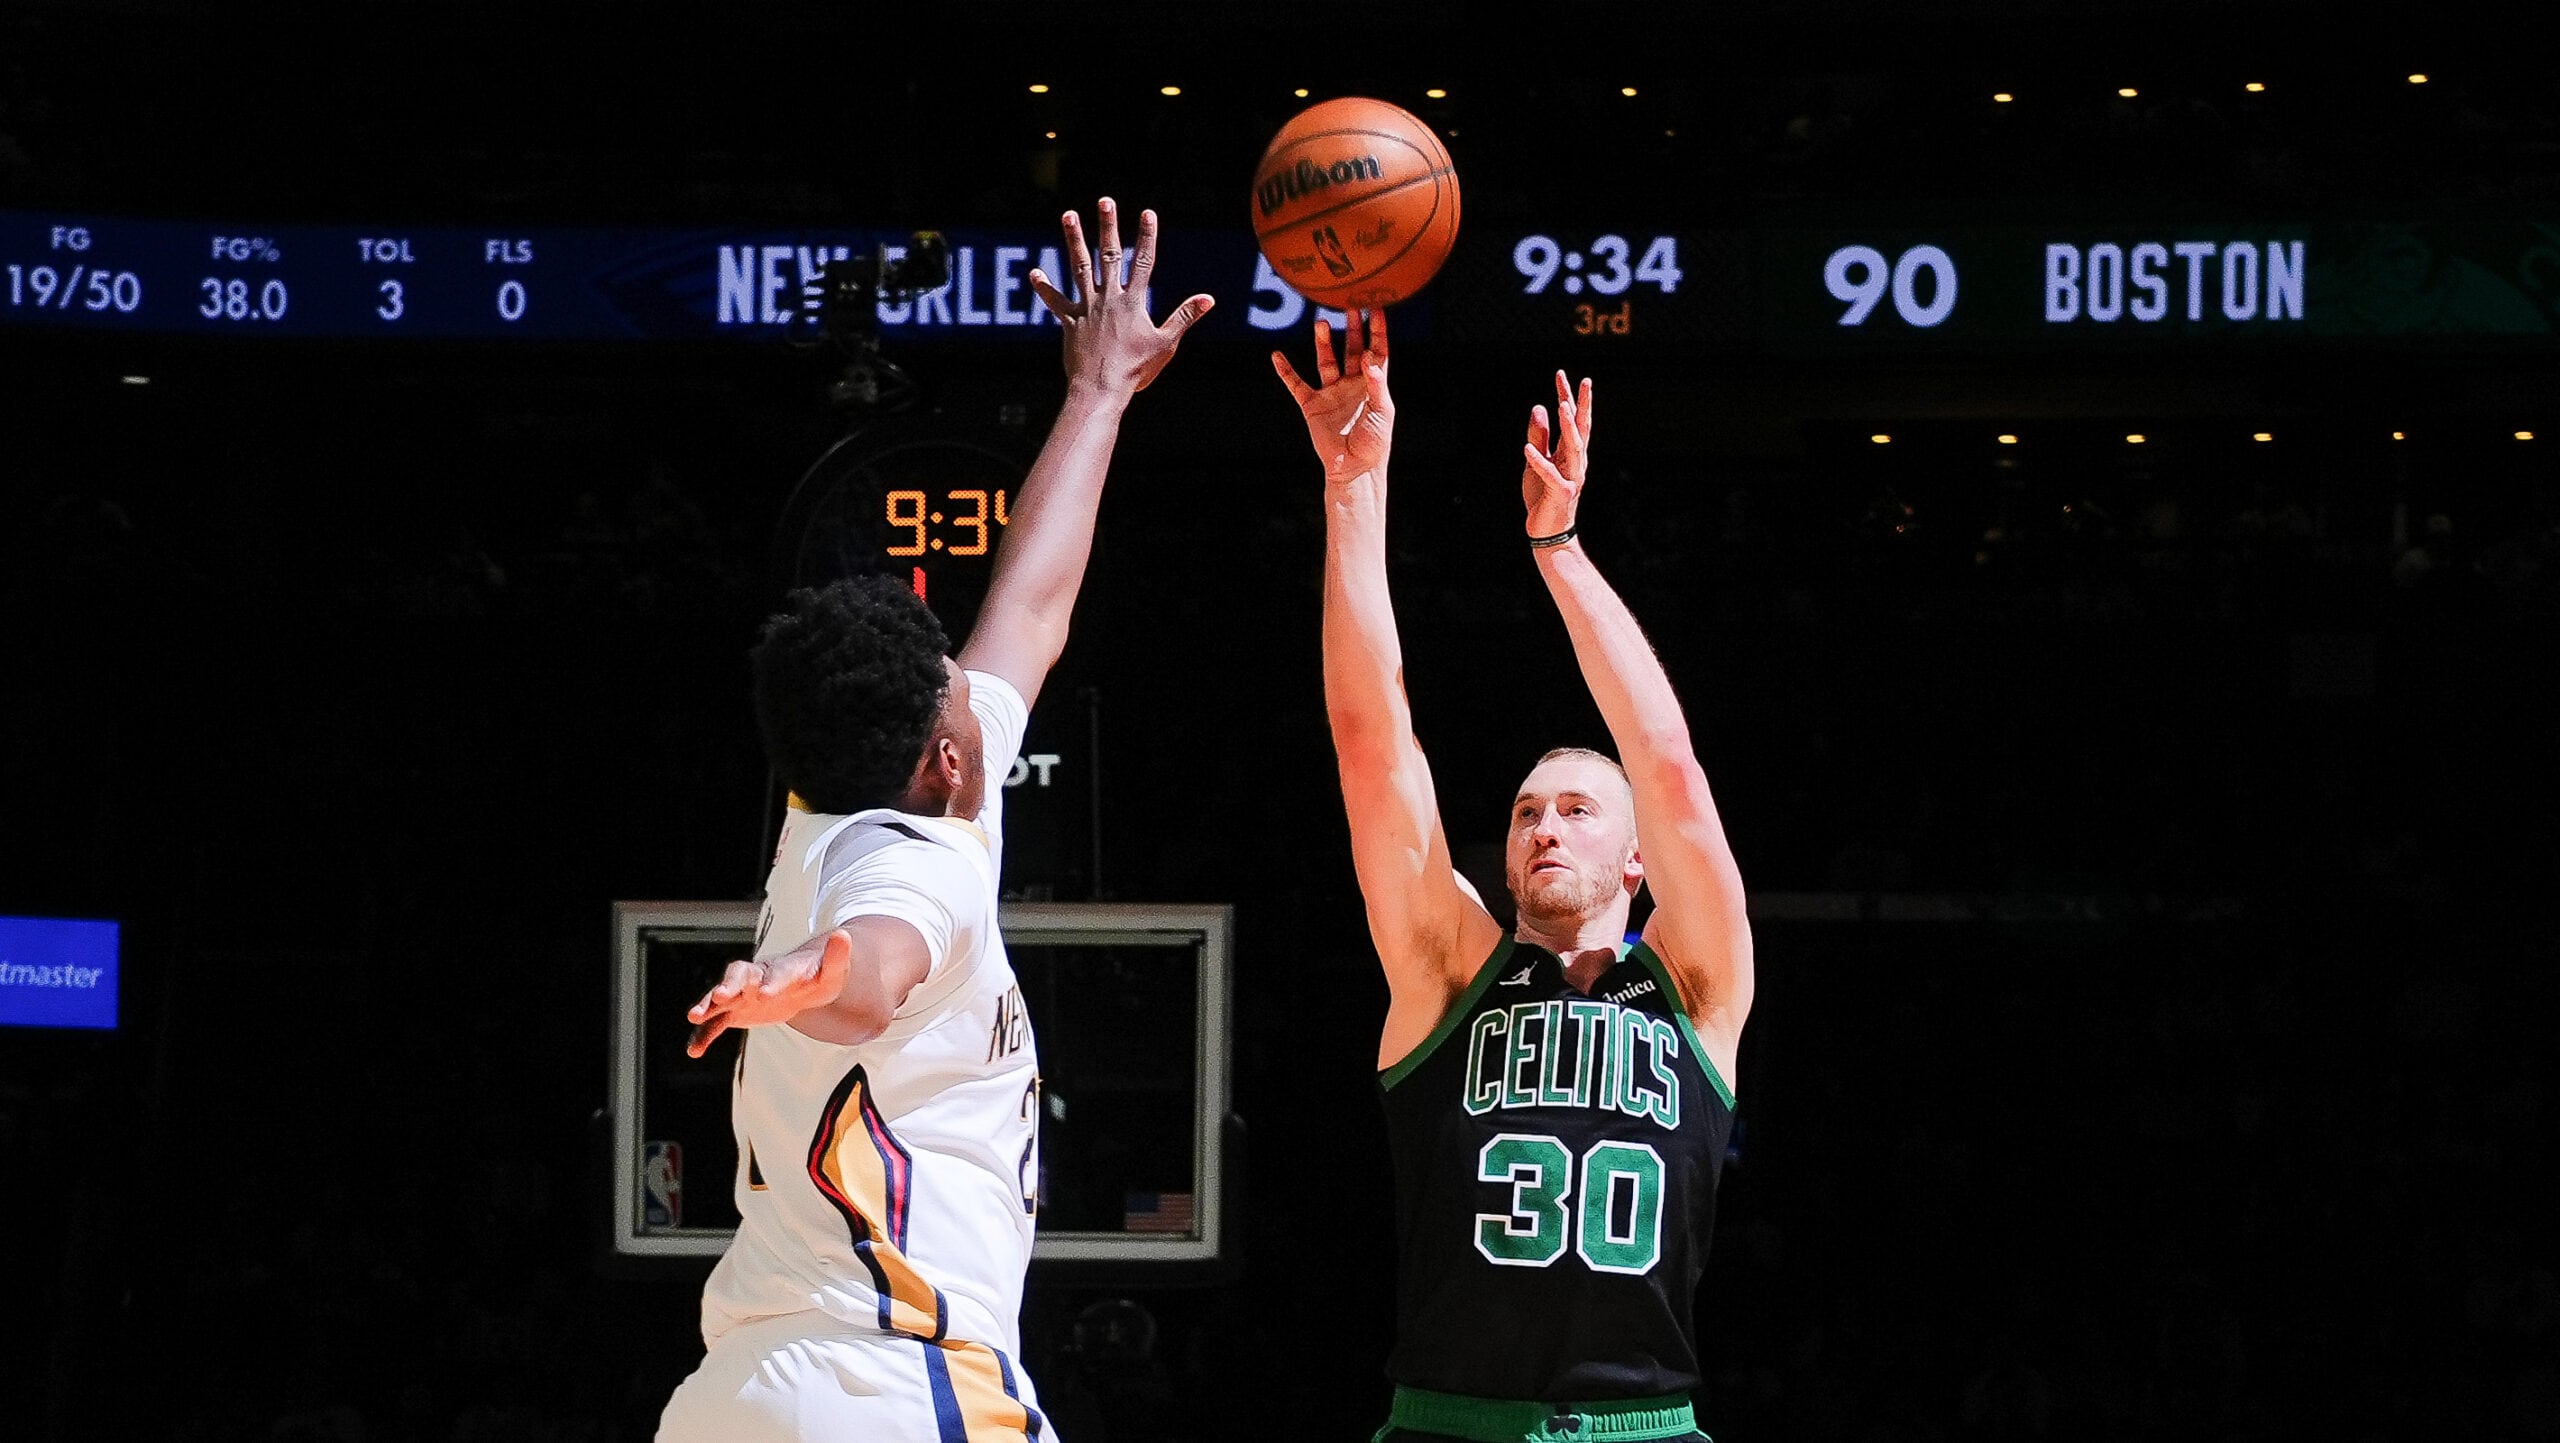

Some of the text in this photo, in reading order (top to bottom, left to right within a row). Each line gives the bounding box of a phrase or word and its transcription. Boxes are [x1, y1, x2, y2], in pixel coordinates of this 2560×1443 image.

[1257, 154, 1384, 217] Wilson
[51, 226, 91, 251] FG
[212, 236, 280, 262] FG%
[358, 238, 415, 263] TOL
[485, 239, 533, 264] FLS
[1513, 235, 1683, 295] 9:34
[1823, 244, 1958, 328] 90
[2045, 240, 2305, 323] BOSTON
[8, 264, 142, 313] 19/50
[200, 277, 288, 321] 38.0
[378, 279, 404, 321] 3
[497, 280, 527, 321] 0
[1575, 303, 1631, 335] 3rd
[1463, 1000, 1681, 1131] CELTICS
[1473, 1133, 1666, 1276] 30
